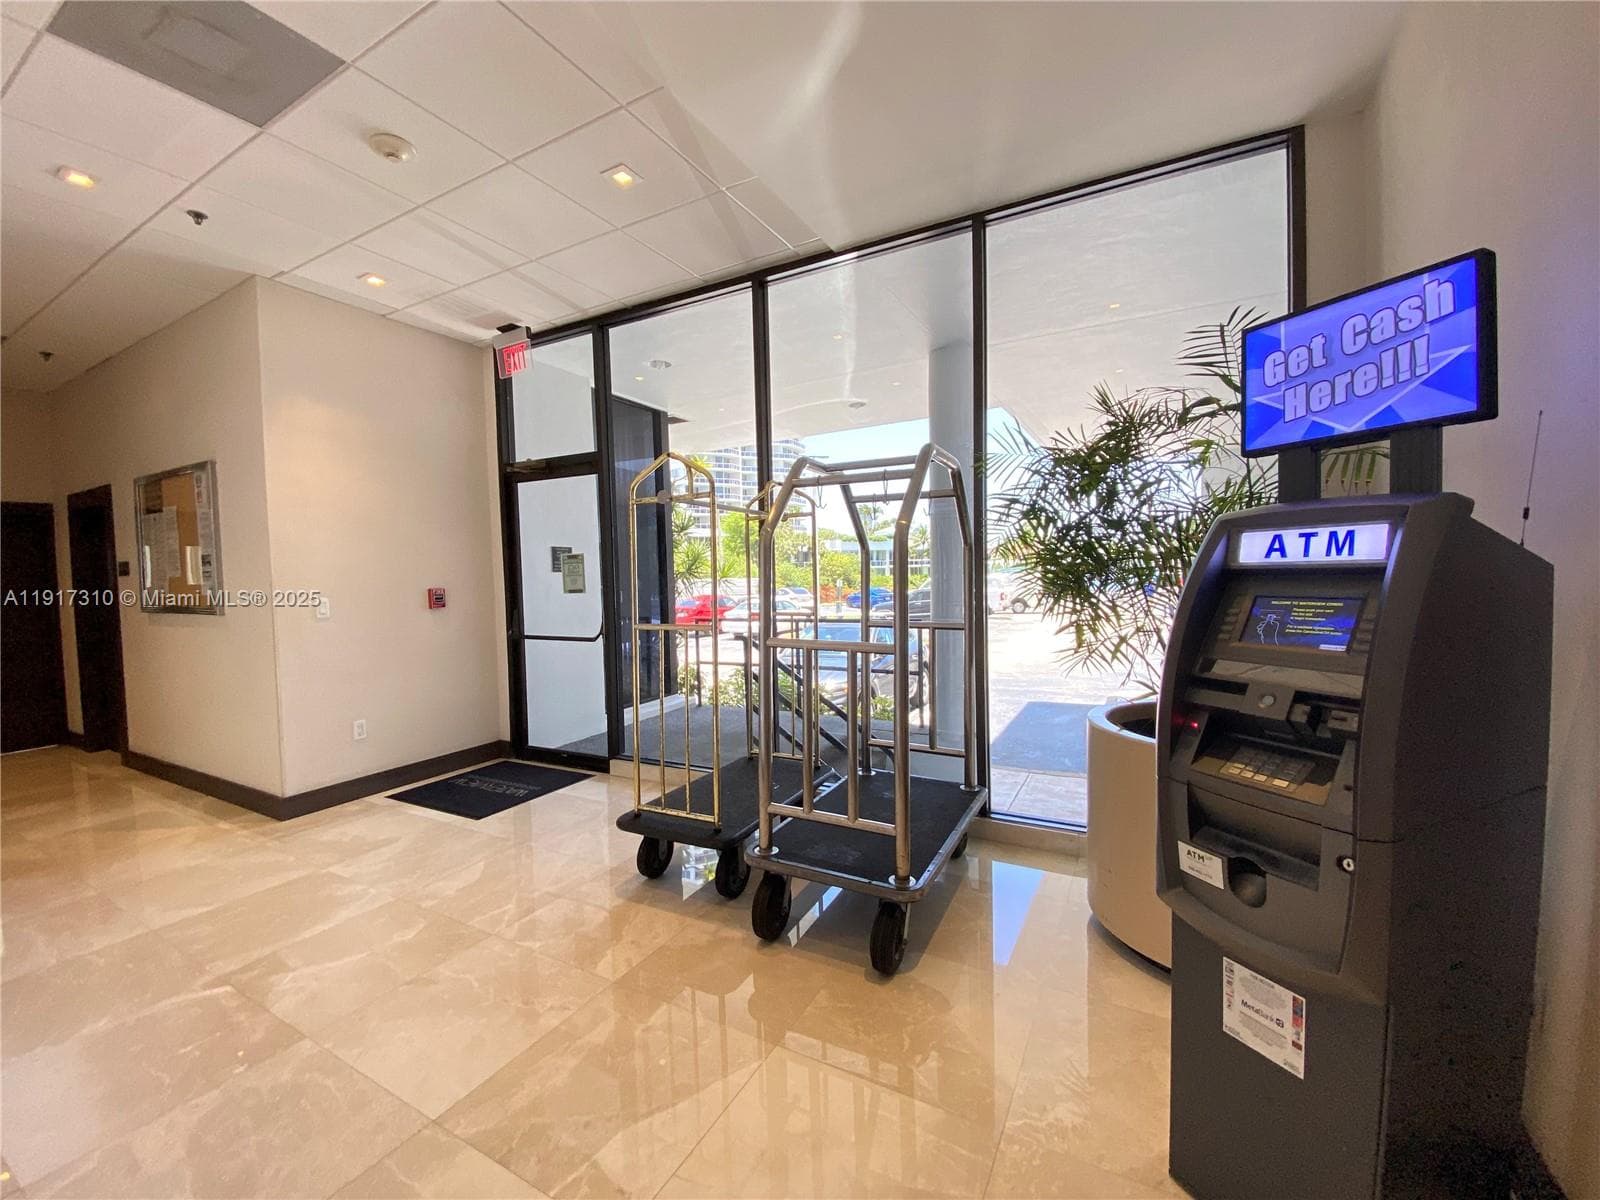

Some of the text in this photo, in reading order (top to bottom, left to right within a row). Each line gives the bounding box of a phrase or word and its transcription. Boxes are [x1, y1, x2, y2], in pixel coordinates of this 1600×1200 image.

[1264, 278, 1455, 387] Get Cash
[503, 342, 528, 375] EXIT
[1283, 334, 1430, 423] Here!!!
[1264, 529, 1356, 559] ATM
[1186, 849, 1206, 863] ATM
